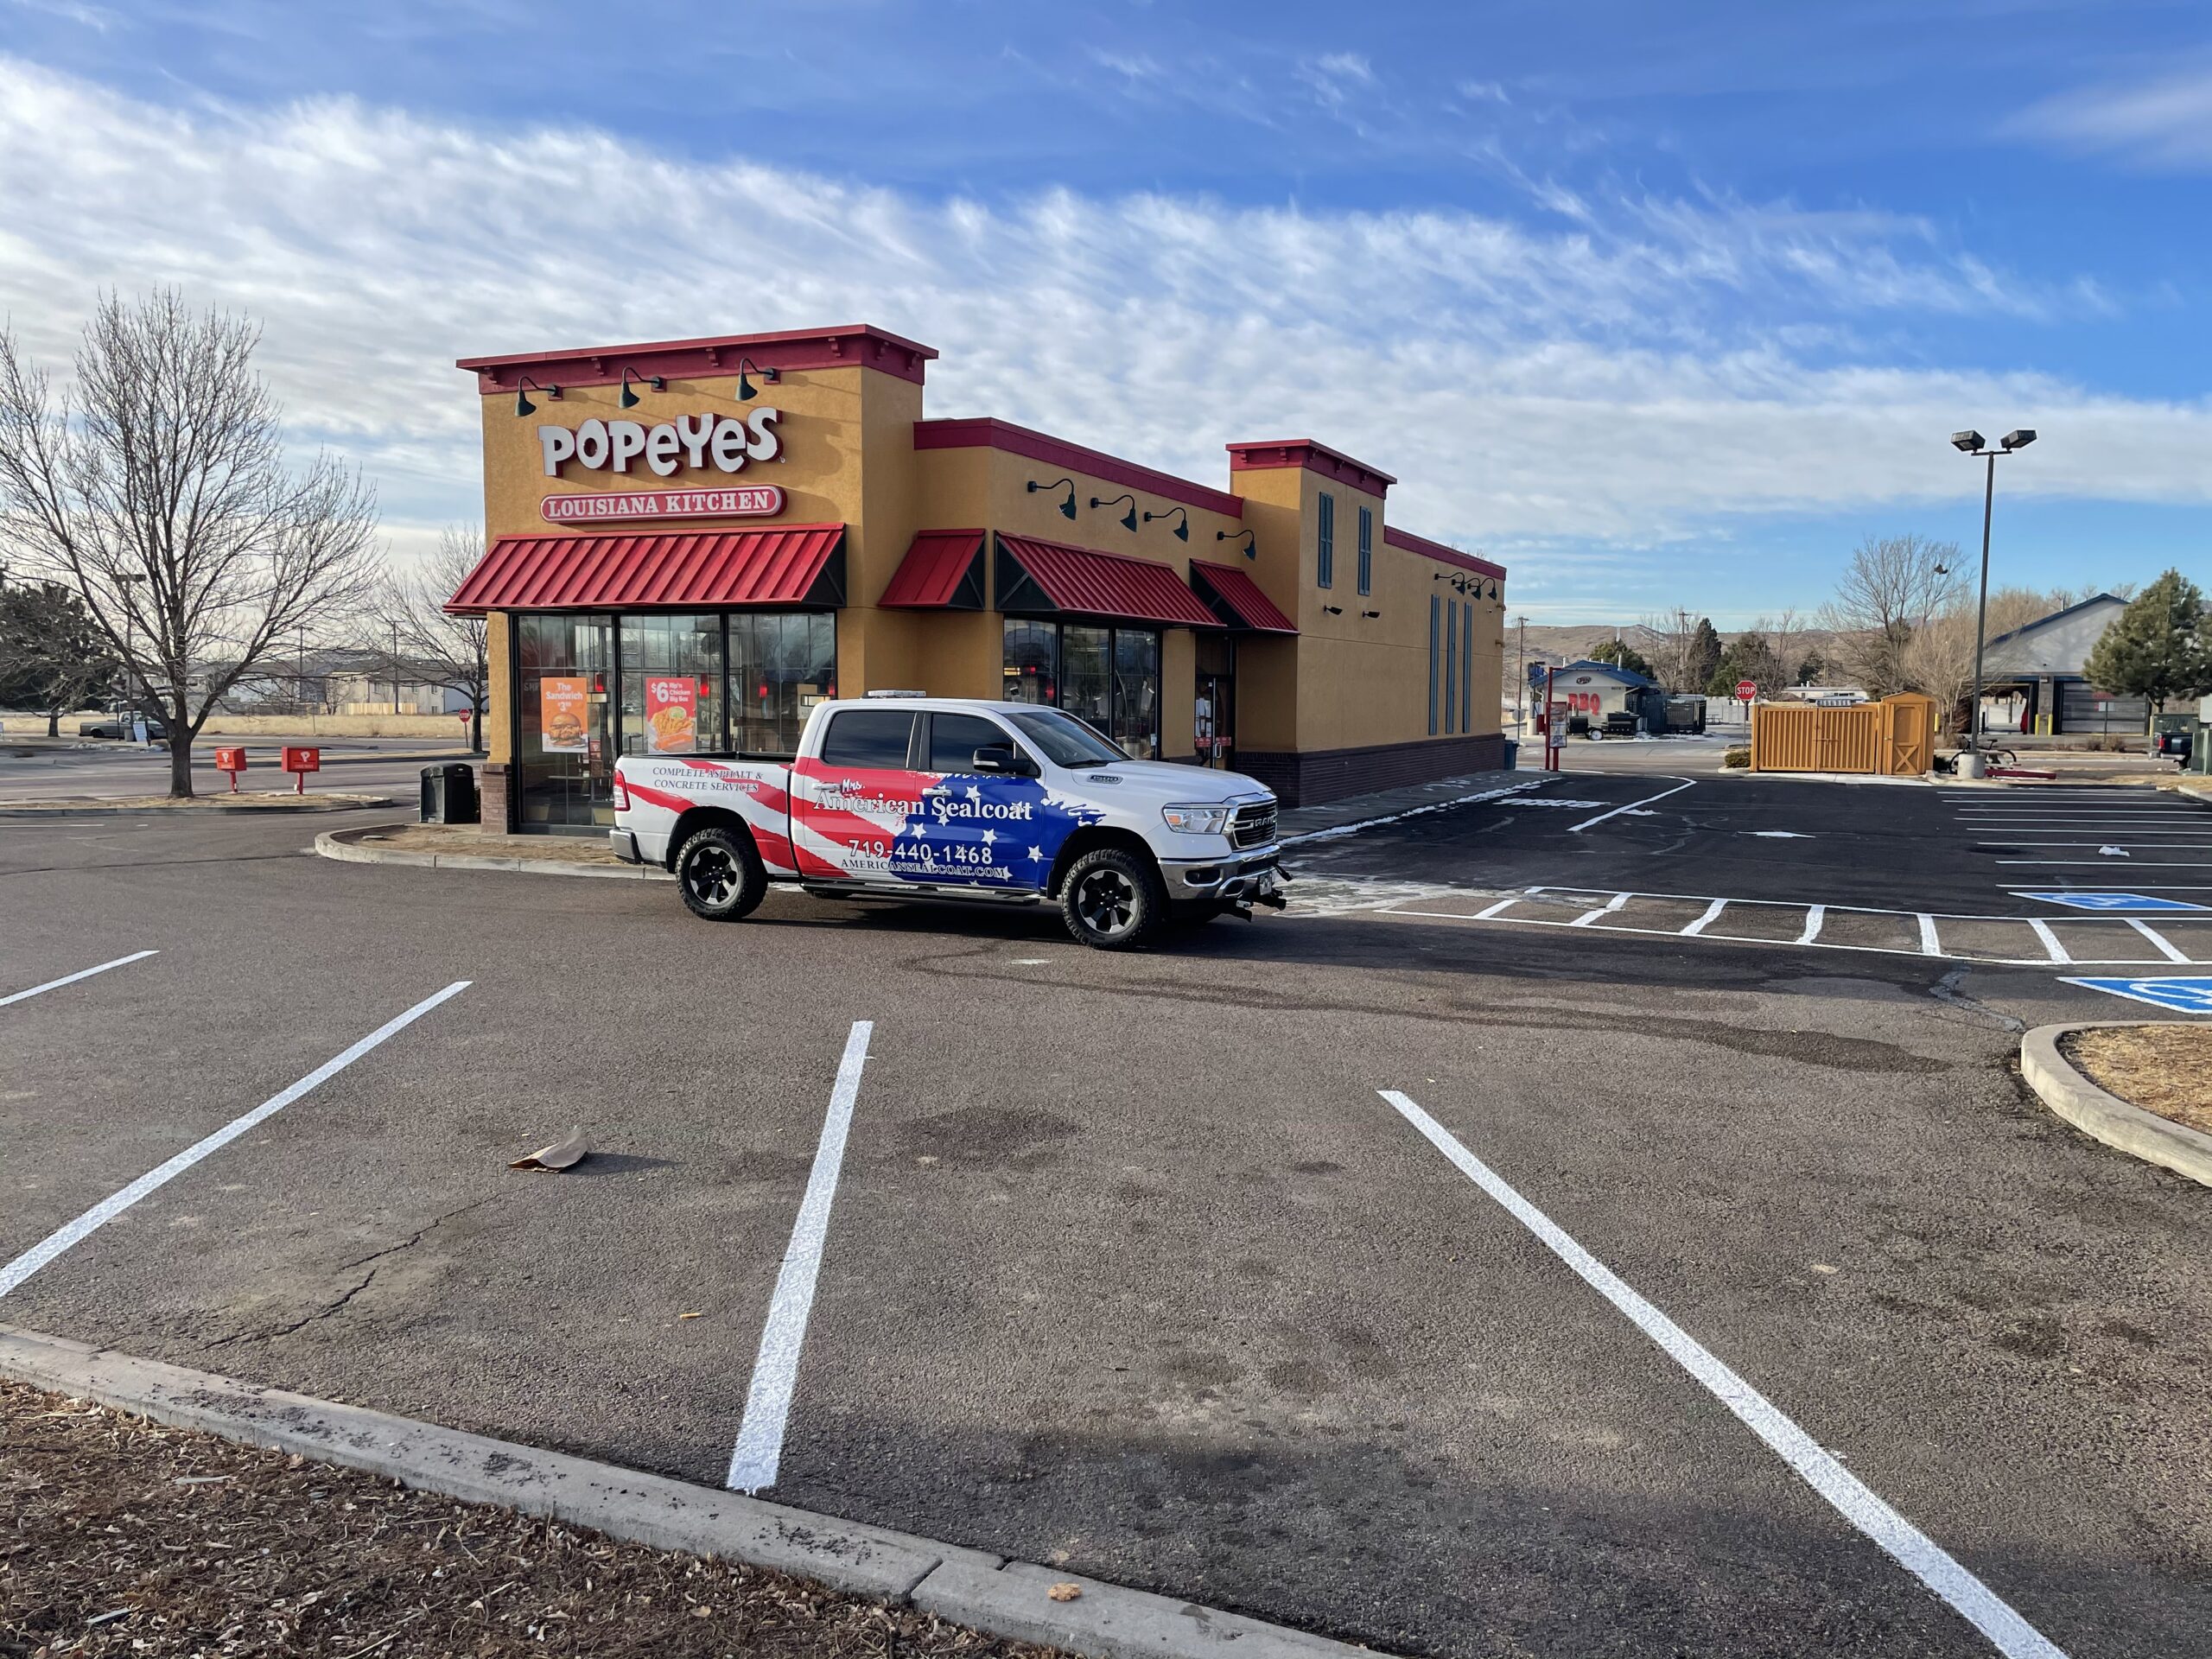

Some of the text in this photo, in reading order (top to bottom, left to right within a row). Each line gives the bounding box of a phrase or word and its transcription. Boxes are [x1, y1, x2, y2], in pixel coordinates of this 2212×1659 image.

[548, 491, 769, 518] LOUISIANA KITCHEN
[556, 683, 572, 691] The
[651, 681, 670, 702] $6
[1737, 686, 1756, 695] STOP
[546, 691, 583, 701] Sandwich
[652, 766, 706, 779] COMPLETE
[708, 769, 753, 779] ASPHALT
[654, 779, 759, 792] CONCRETE SERVICES
[842, 779, 866, 793] Mrs.
[813, 790, 1033, 821] American Sealcoat
[849, 839, 993, 865] 719-440-1468
[841, 859, 1005, 878] AMERICANSEALCOAT.COM
